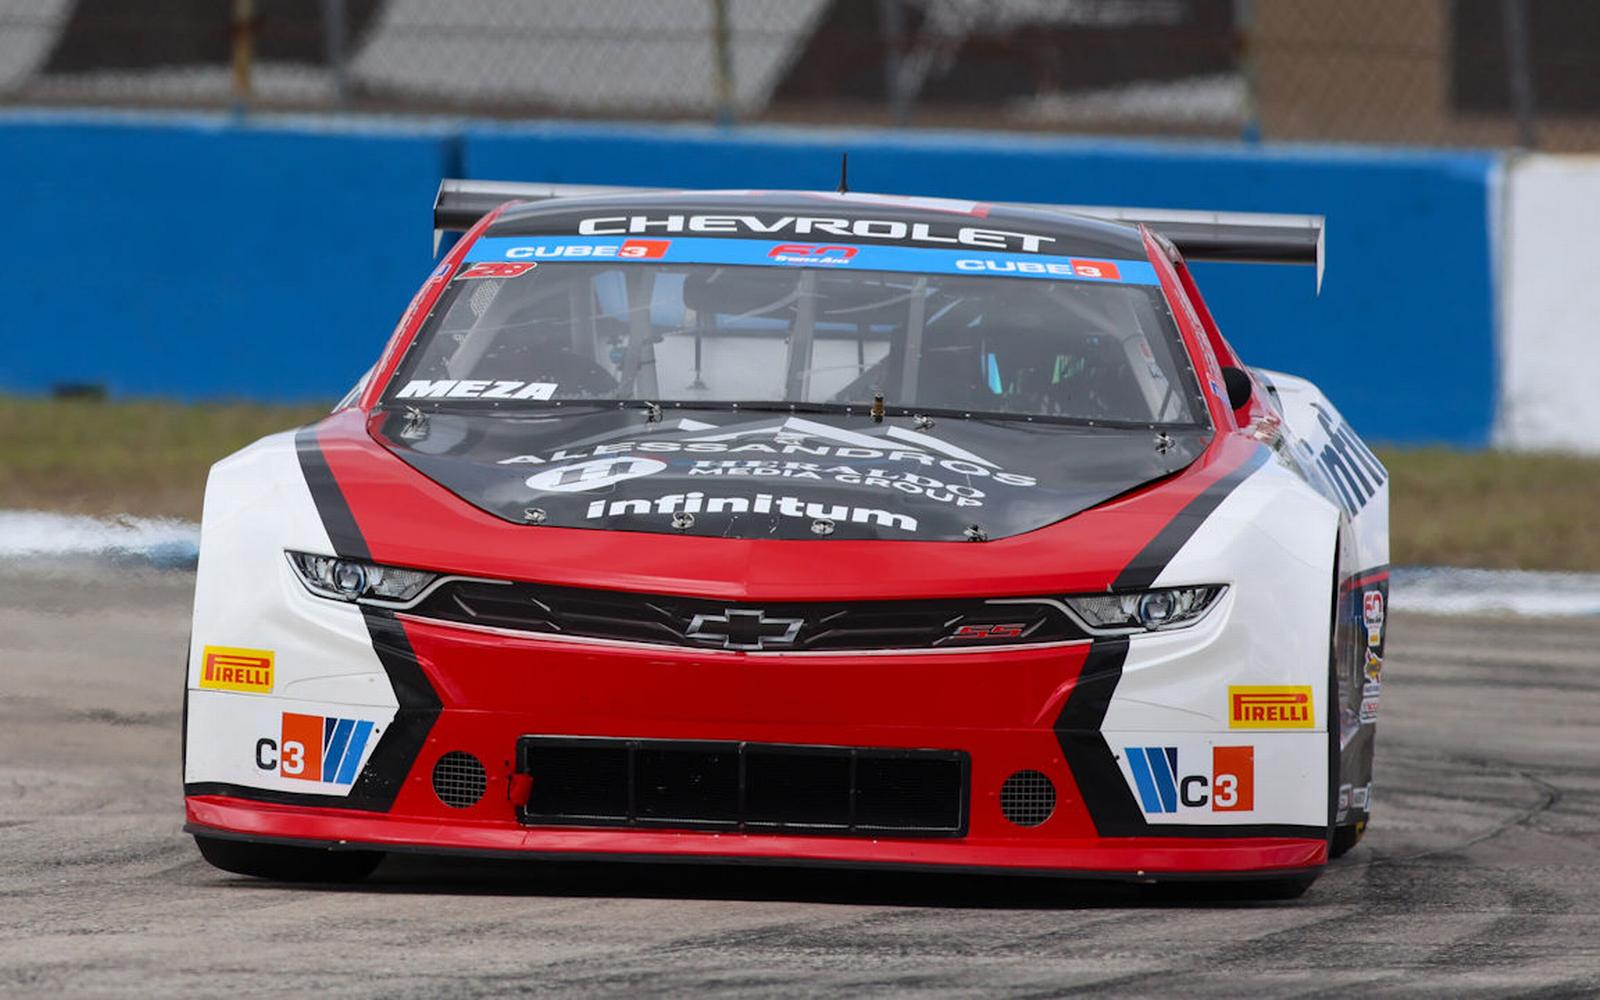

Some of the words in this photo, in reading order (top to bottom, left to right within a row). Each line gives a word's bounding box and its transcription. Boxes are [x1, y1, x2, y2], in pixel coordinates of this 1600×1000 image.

[578, 215, 1055, 252] CHEVROLET
[505, 245, 649, 259] CUBE3
[956, 259, 1102, 278] CUBE3
[395, 380, 559, 400] MEZA
[496, 441, 1037, 486] ALESSANDROS
[694, 459, 986, 499] HERALDO
[688, 466, 823, 480] MEDIA
[835, 474, 983, 507] GROUP
[586, 491, 918, 532] infinitum
[951, 624, 1027, 639] SS
[205, 653, 271, 686] PIRELLI
[1232, 693, 1309, 721] PIRELLI
[255, 738, 305, 774] C3
[1180, 774, 1238, 807] C3
